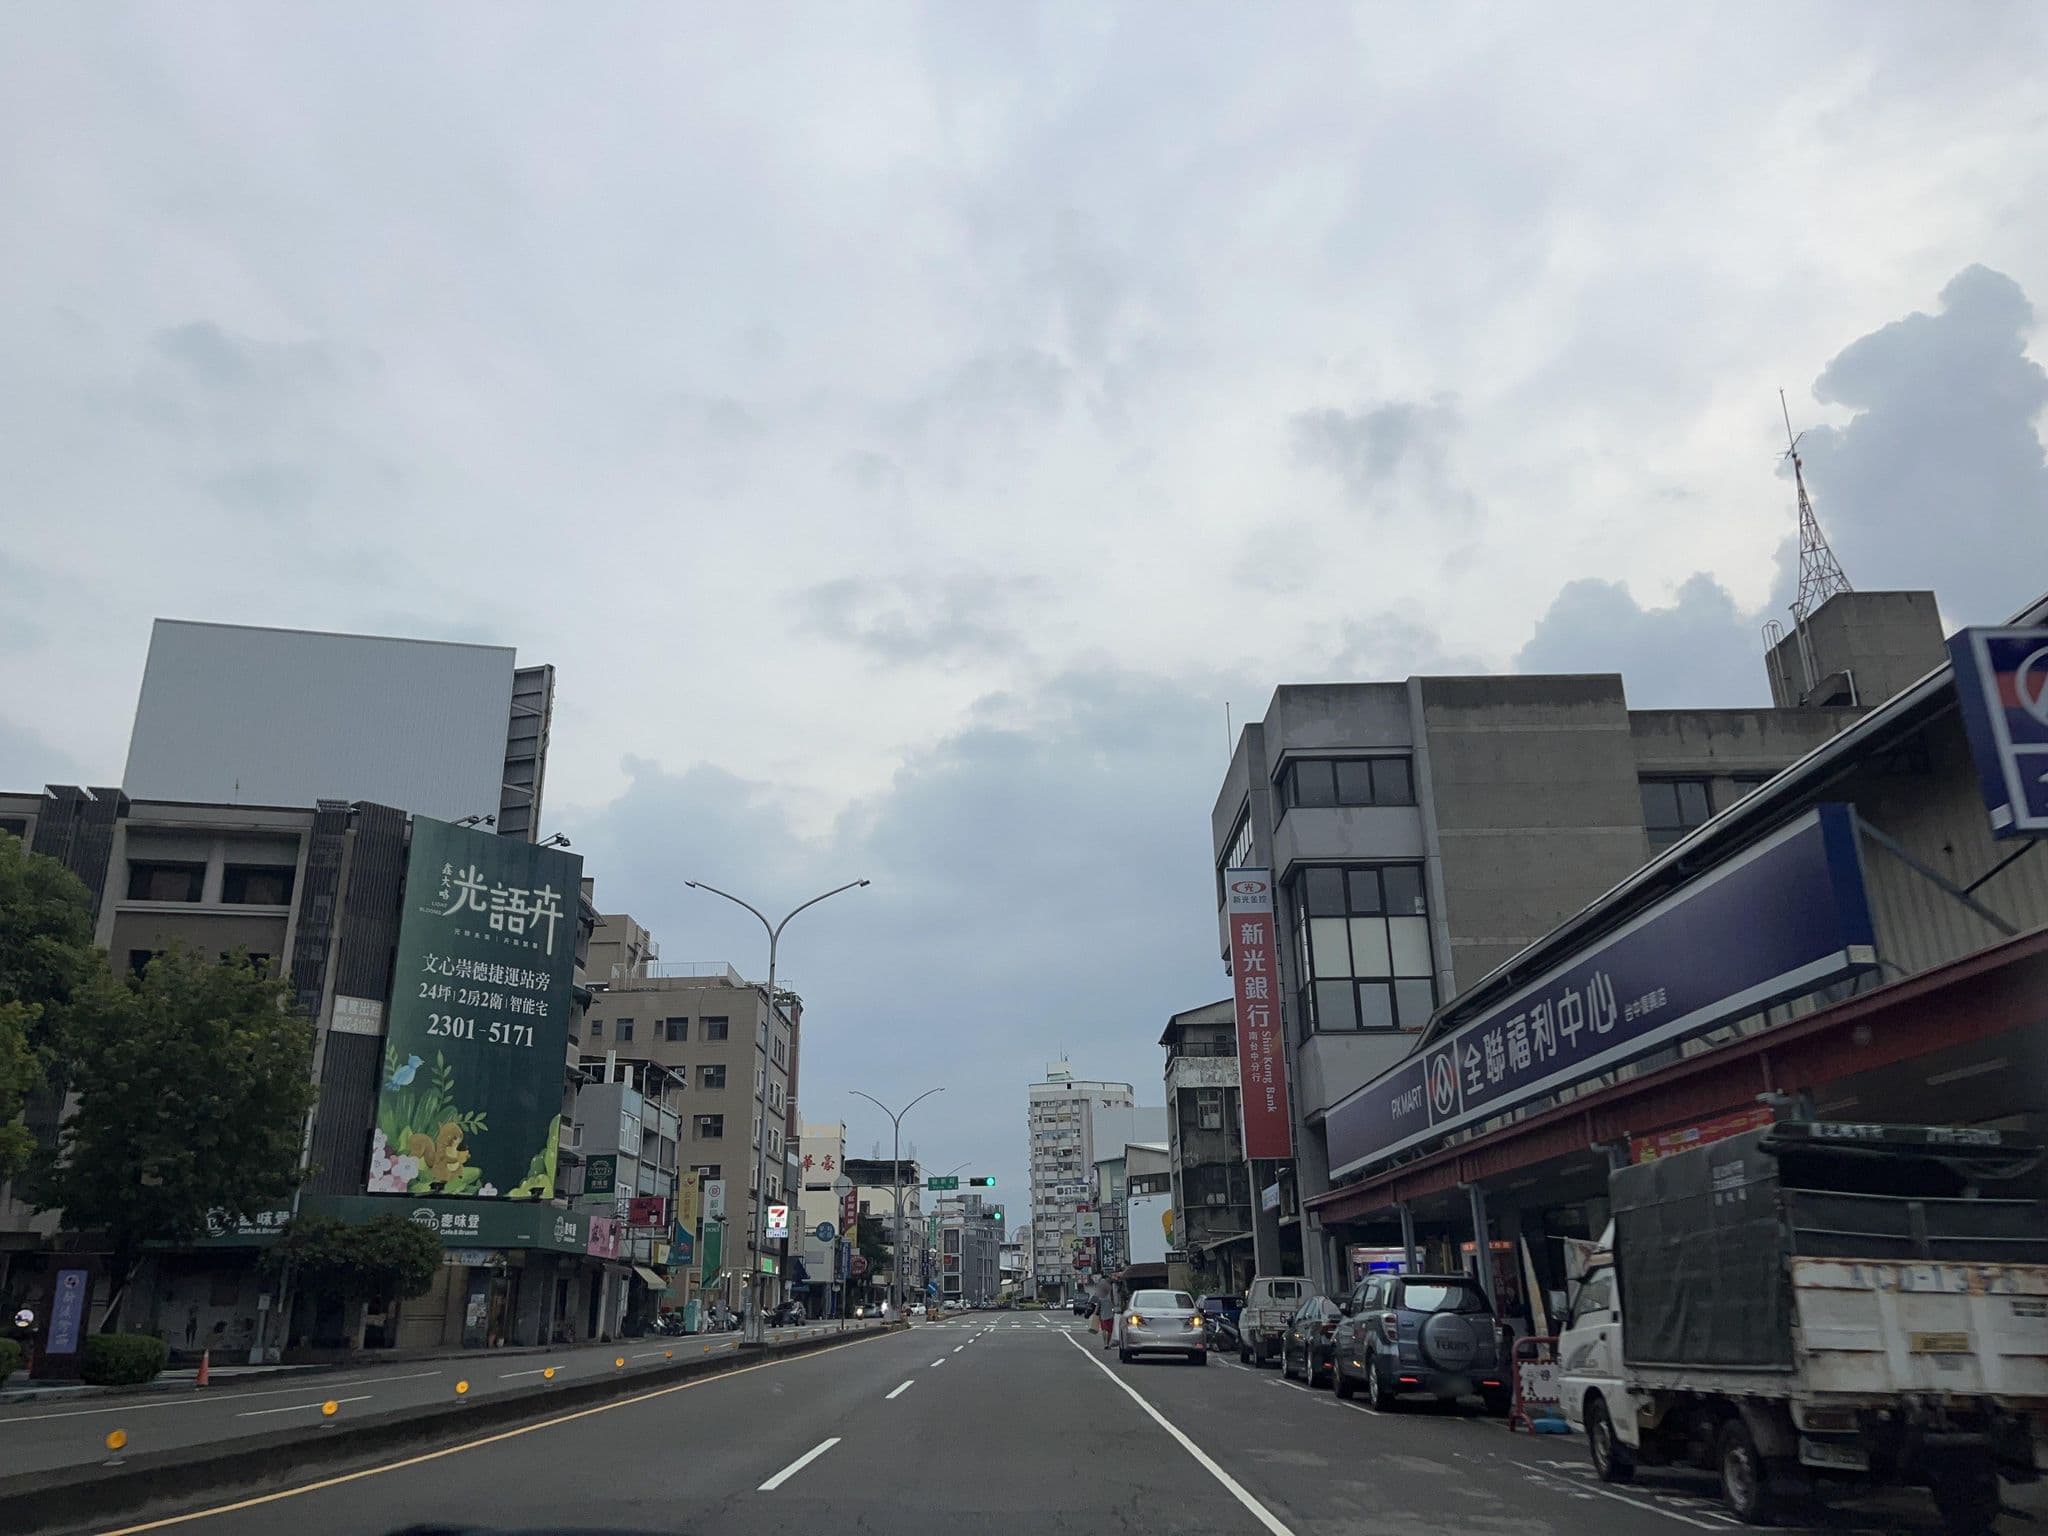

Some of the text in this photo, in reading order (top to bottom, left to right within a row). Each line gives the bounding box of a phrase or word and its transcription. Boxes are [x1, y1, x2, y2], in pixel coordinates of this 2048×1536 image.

[422, 953, 550, 991] 文心崇德捷運站旁
[1241, 923, 1269, 1027] 新光銀行
[427, 1013, 533, 1047] 2301-5171
[1463, 970, 1617, 1095] 全聯福利中心
[1262, 1031, 1277, 1113] Shin Kong Bank
